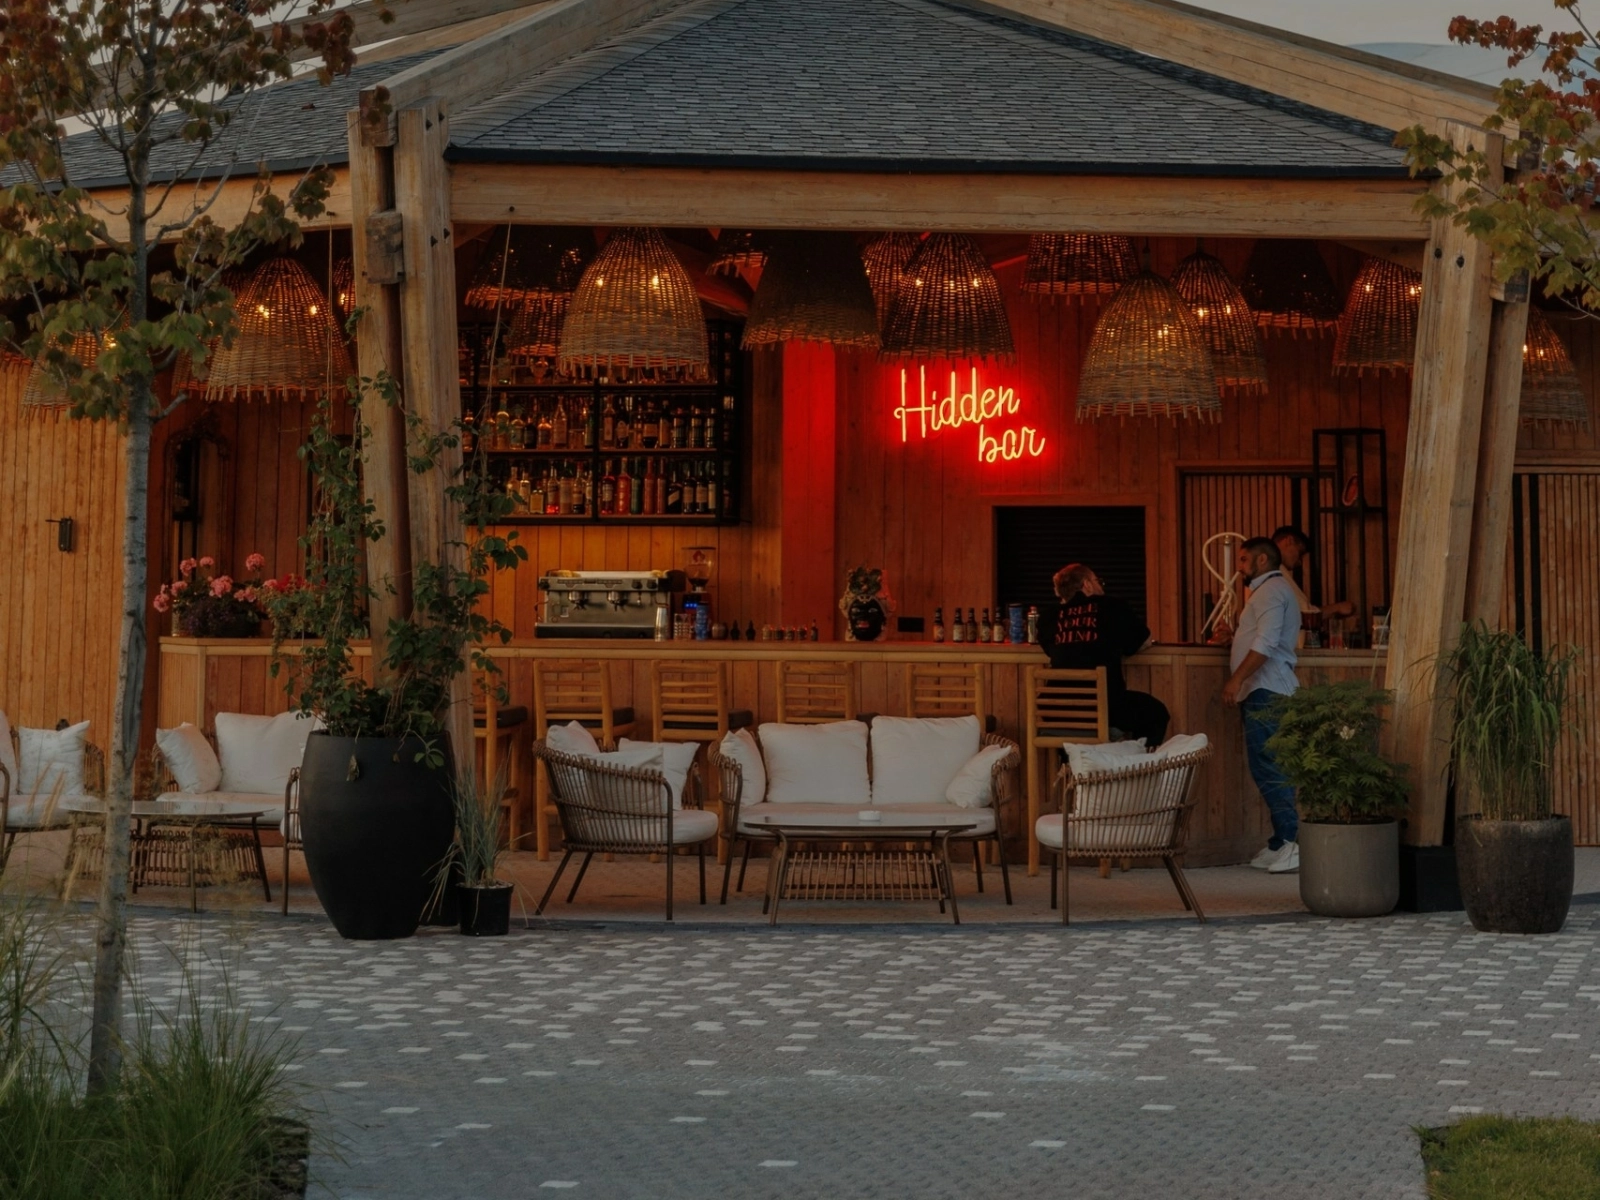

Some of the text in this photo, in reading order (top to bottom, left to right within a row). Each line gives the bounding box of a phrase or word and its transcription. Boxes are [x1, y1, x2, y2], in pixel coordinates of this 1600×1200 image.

[893, 365, 1020, 442] Hidden
[978, 424, 1046, 463] bar
[1055, 631, 1098, 645] MIND
[1057, 617, 1097, 632] YOUR
